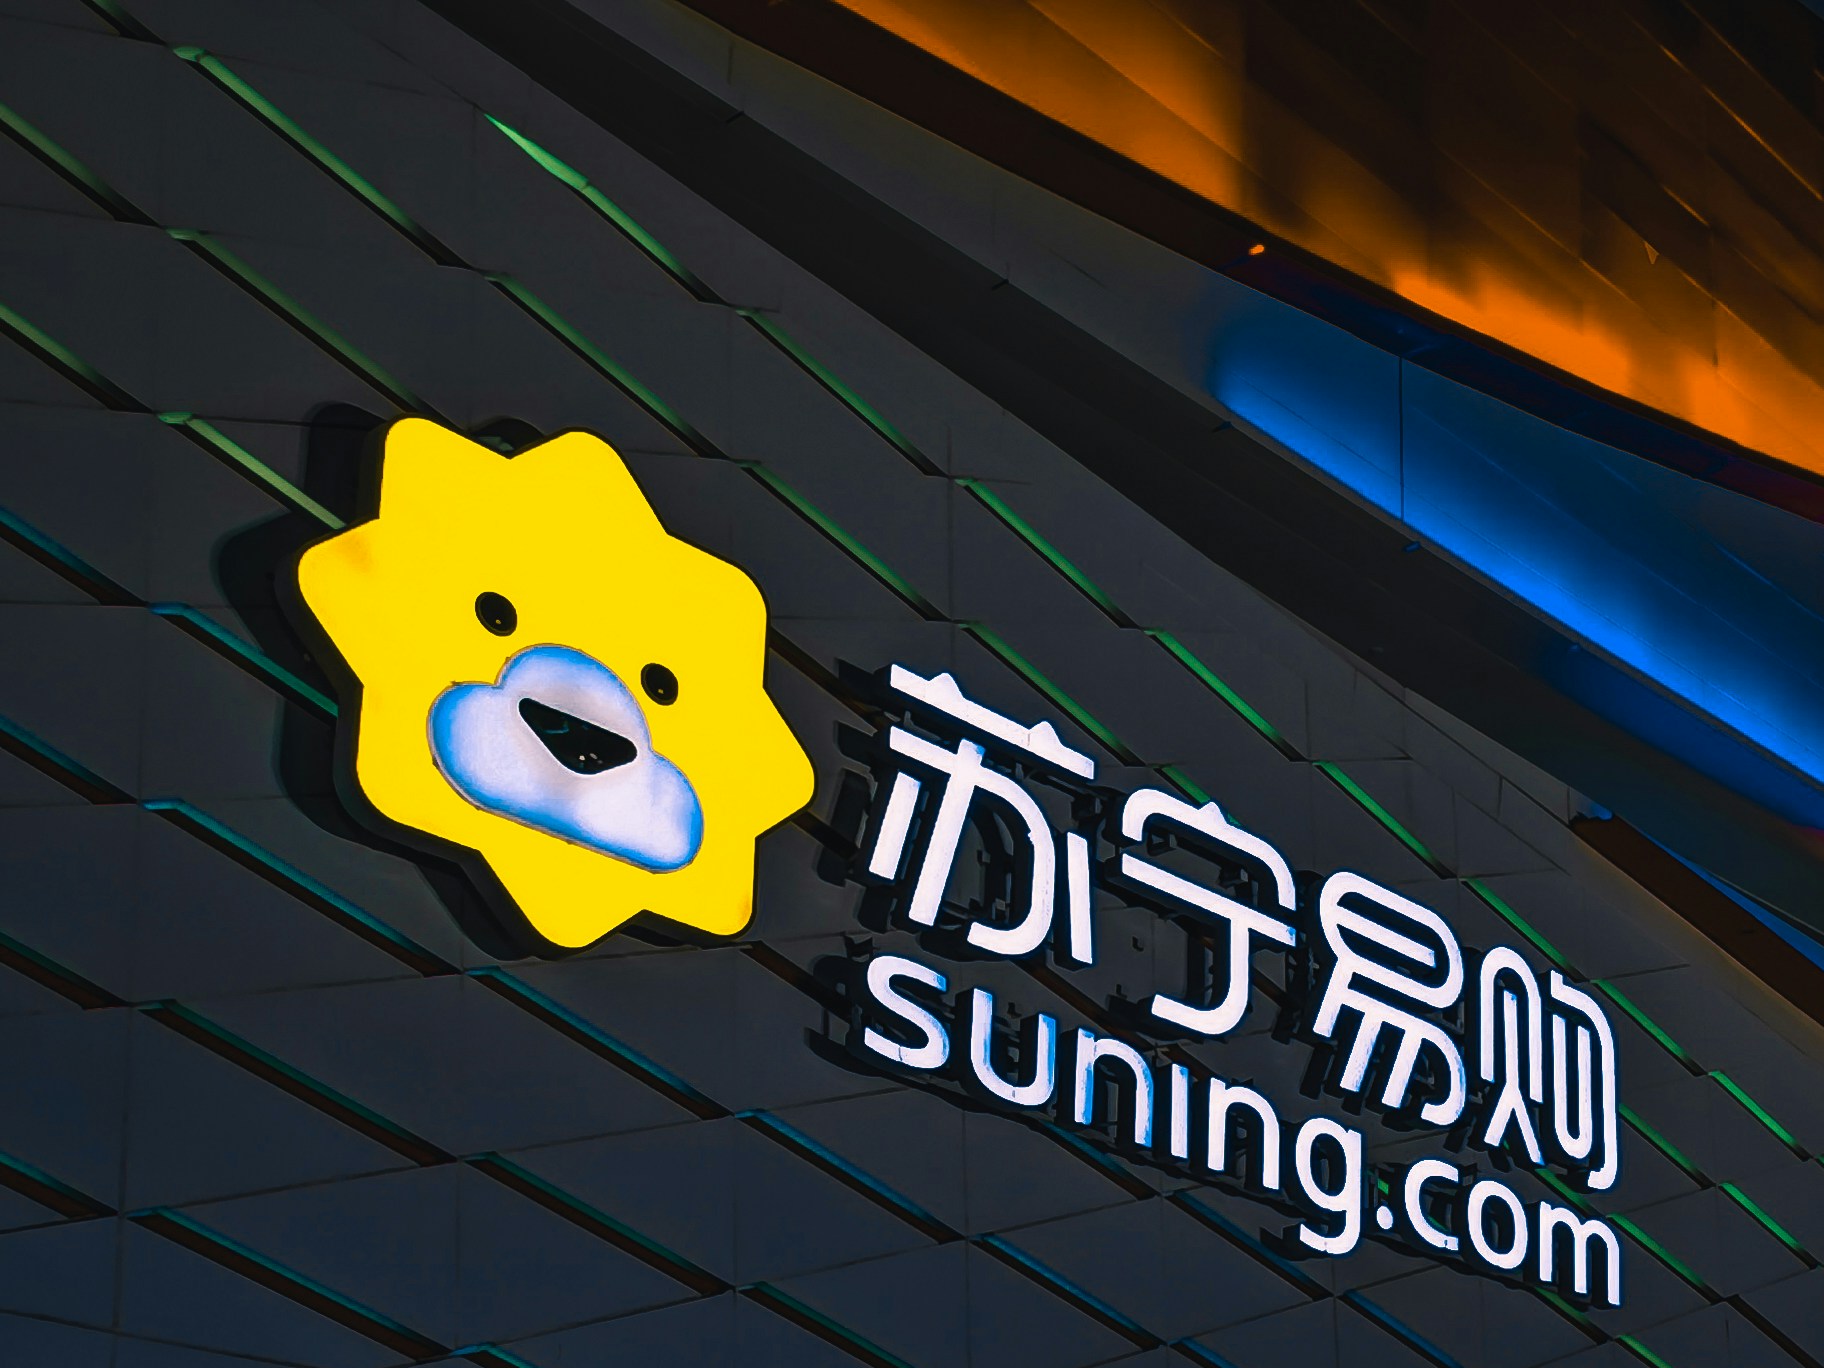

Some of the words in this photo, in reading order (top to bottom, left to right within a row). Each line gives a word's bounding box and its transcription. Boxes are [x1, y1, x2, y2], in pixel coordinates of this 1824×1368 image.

[865, 956, 1621, 1305] suning.com
[869, 664, 1620, 1190] 苏宁易购
